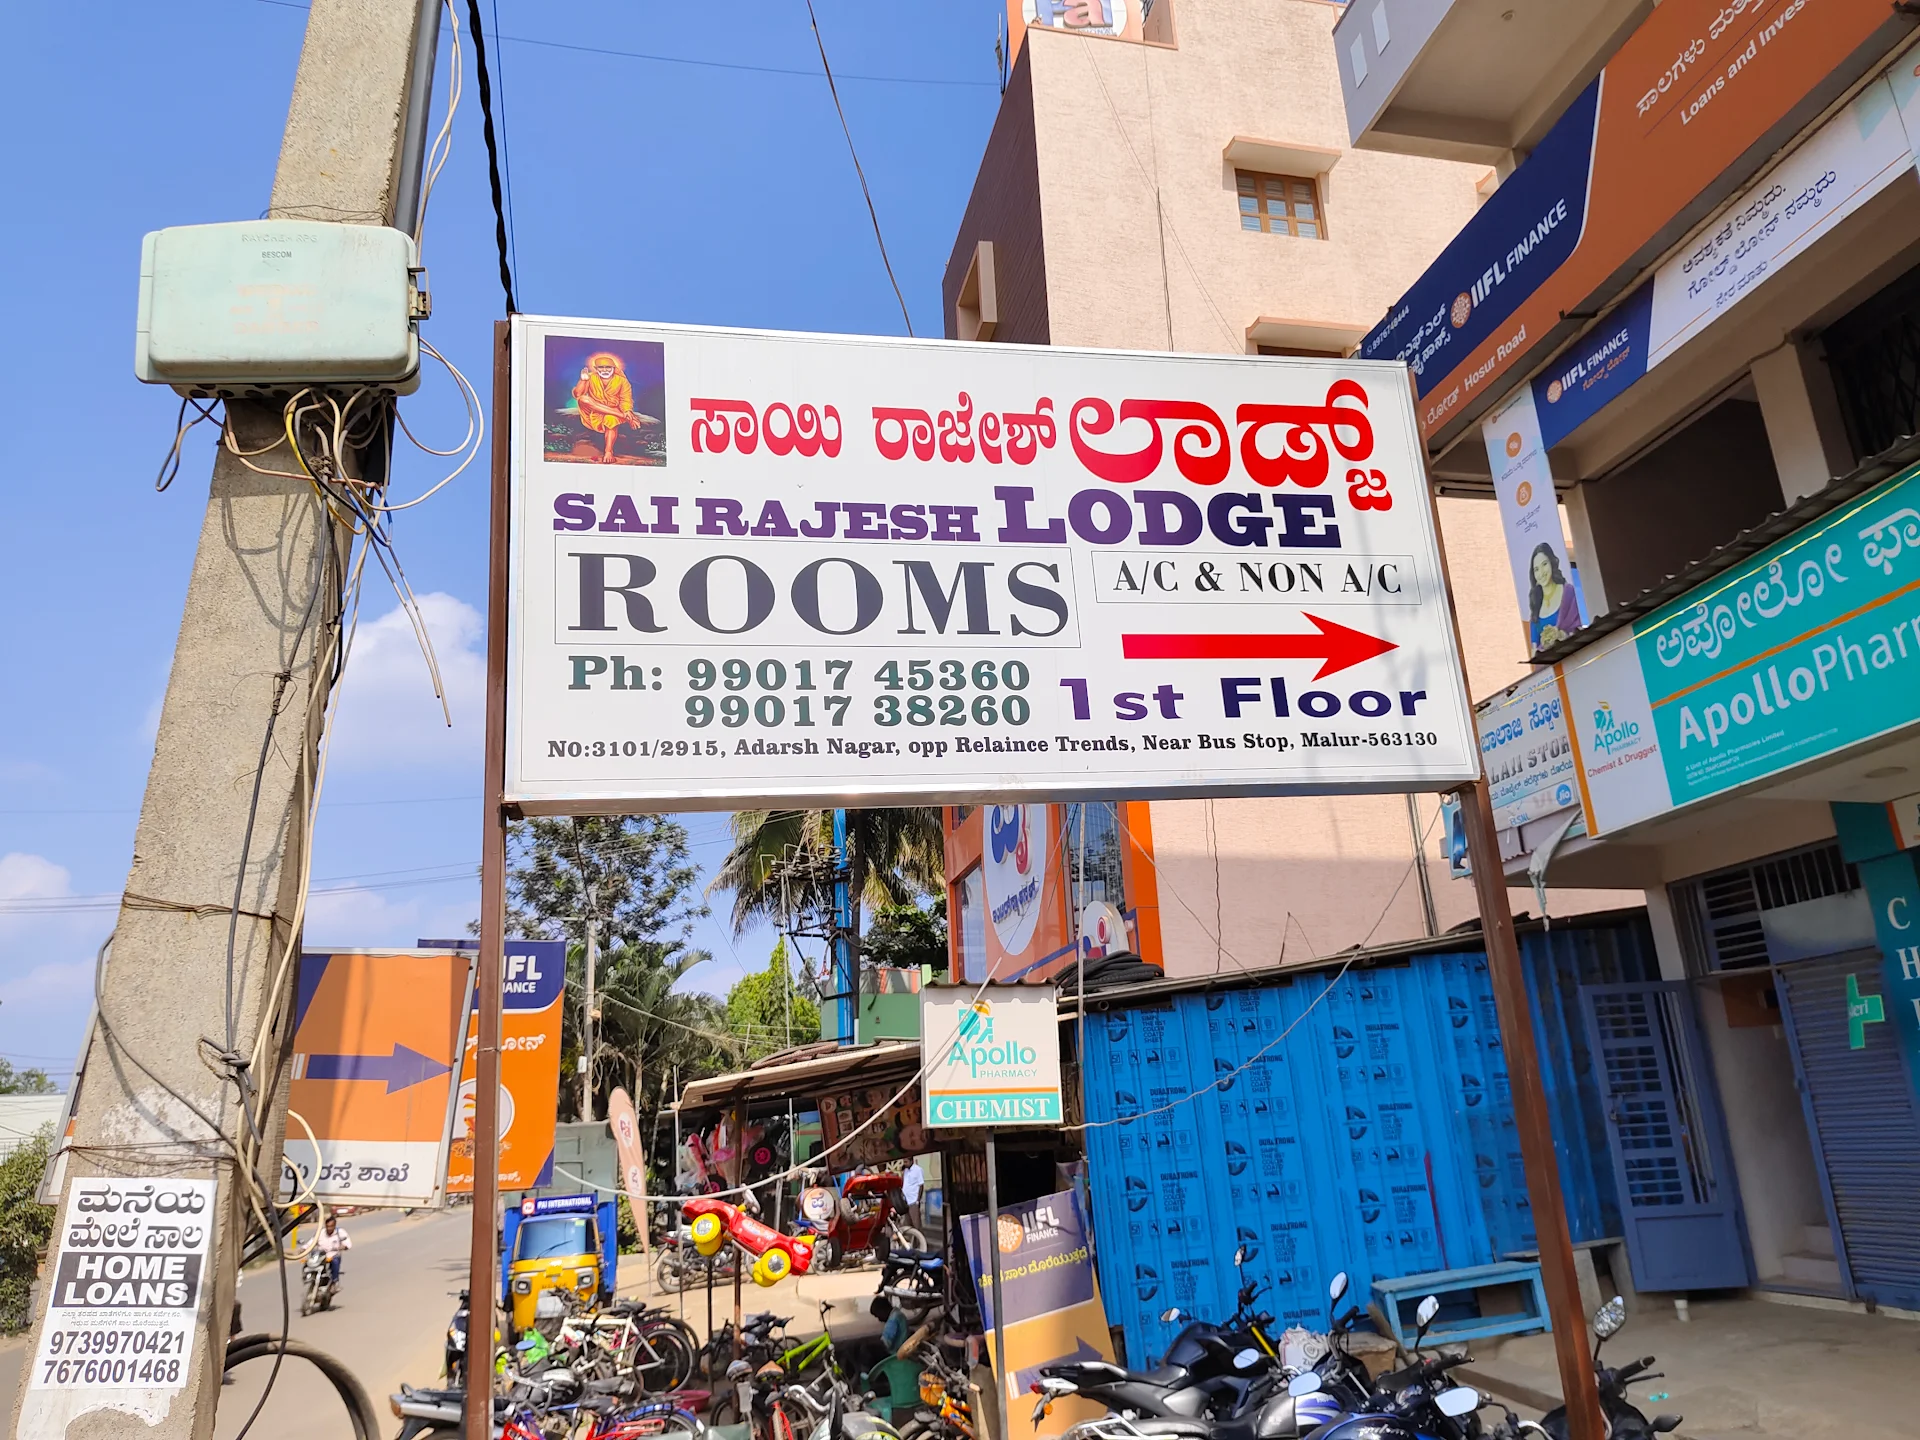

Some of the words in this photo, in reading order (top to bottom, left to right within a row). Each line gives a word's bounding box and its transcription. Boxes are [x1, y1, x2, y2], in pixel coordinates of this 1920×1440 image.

[1680, 76, 1725, 126] Loans
[1728, 39, 1757, 79] and
[1758, 0, 1811, 47] Inves
[1735, 212, 1780, 260] ಲೋನ್
[1785, 170, 1837, 220] ನಮ್ಮದು
[1470, 261, 1505, 308] IIFL
[1506, 198, 1568, 273] FINANCE
[1463, 355, 1496, 392] Hosur
[1496, 324, 1527, 362] Road
[1561, 362, 1587, 391] IIFL
[1586, 328, 1630, 372] FINANCE
[690, 397, 842, 459] ಸಾಯಿ
[872, 390, 1057, 466] ರಾಜೇಶ್
[553, 493, 680, 534] SAI
[695, 497, 981, 543] RAJESH
[994, 485, 1342, 548] LODGE
[567, 552, 1070, 637] ROOMS
[1112, 560, 1179, 595] A/C
[1194, 561, 1225, 593] &
[1239, 563, 1325, 593] NON
[1340, 562, 1403, 597] A/C
[1655, 542, 1849, 668] ಅಪೋಲೋ
[567, 655, 663, 691] Ph:
[687, 658, 853, 692] 99017
[873, 659, 1030, 692] 45360
[685, 695, 853, 728] 99017
[873, 695, 1030, 727] 38260
[1059, 678, 1185, 720] 1st
[1220, 677, 1427, 718] Floor
[1480, 717, 1523, 754] ಬಾಲಾಜಿ
[1528, 697, 1563, 731] ಸ್ಟೋ
[1594, 721, 1639, 755] Apollo
[1761, 729, 1785, 743] Limited
[733, 738, 819, 757] Adarsh
[826, 738, 901, 759] Nagar,
[908, 741, 949, 758] opp
[955, 736, 1049, 754] Relaince
[1055, 735, 1136, 754] Trends,
[1143, 734, 1192, 751] Near
[1198, 734, 1237, 750] Bus
[1243, 733, 1295, 752] Stop,
[1301, 731, 1438, 748] Malur-563130
[1587, 760, 1617, 778] Chemist
[1618, 757, 1623, 766] &
[1624, 744, 1657, 763] Druggist
[1557, 787, 1572, 798] Jio
[947, 1040, 1037, 1079] Apollo
[979, 1069, 1038, 1079] PHARMACY
[936, 1098, 1050, 1120] CHEMIST
[357, 1163, 409, 1182] ಶಾಖೆ
[77, 1183, 206, 1215] ಮನೆಯ
[68, 1216, 141, 1248] ಮೇಲೆ
[145, 1224, 203, 1250] ಸಾಲ
[1022, 1206, 1060, 1234] IIFL
[1026, 1227, 1059, 1244] FINANCE
[76, 1255, 188, 1280] HOME
[1004, 1266, 1027, 1280] ಸಾಲ
[63, 1282, 189, 1306] LOANS
[49, 1330, 185, 1355] 9739970421
[43, 1358, 181, 1384] 7676001468
